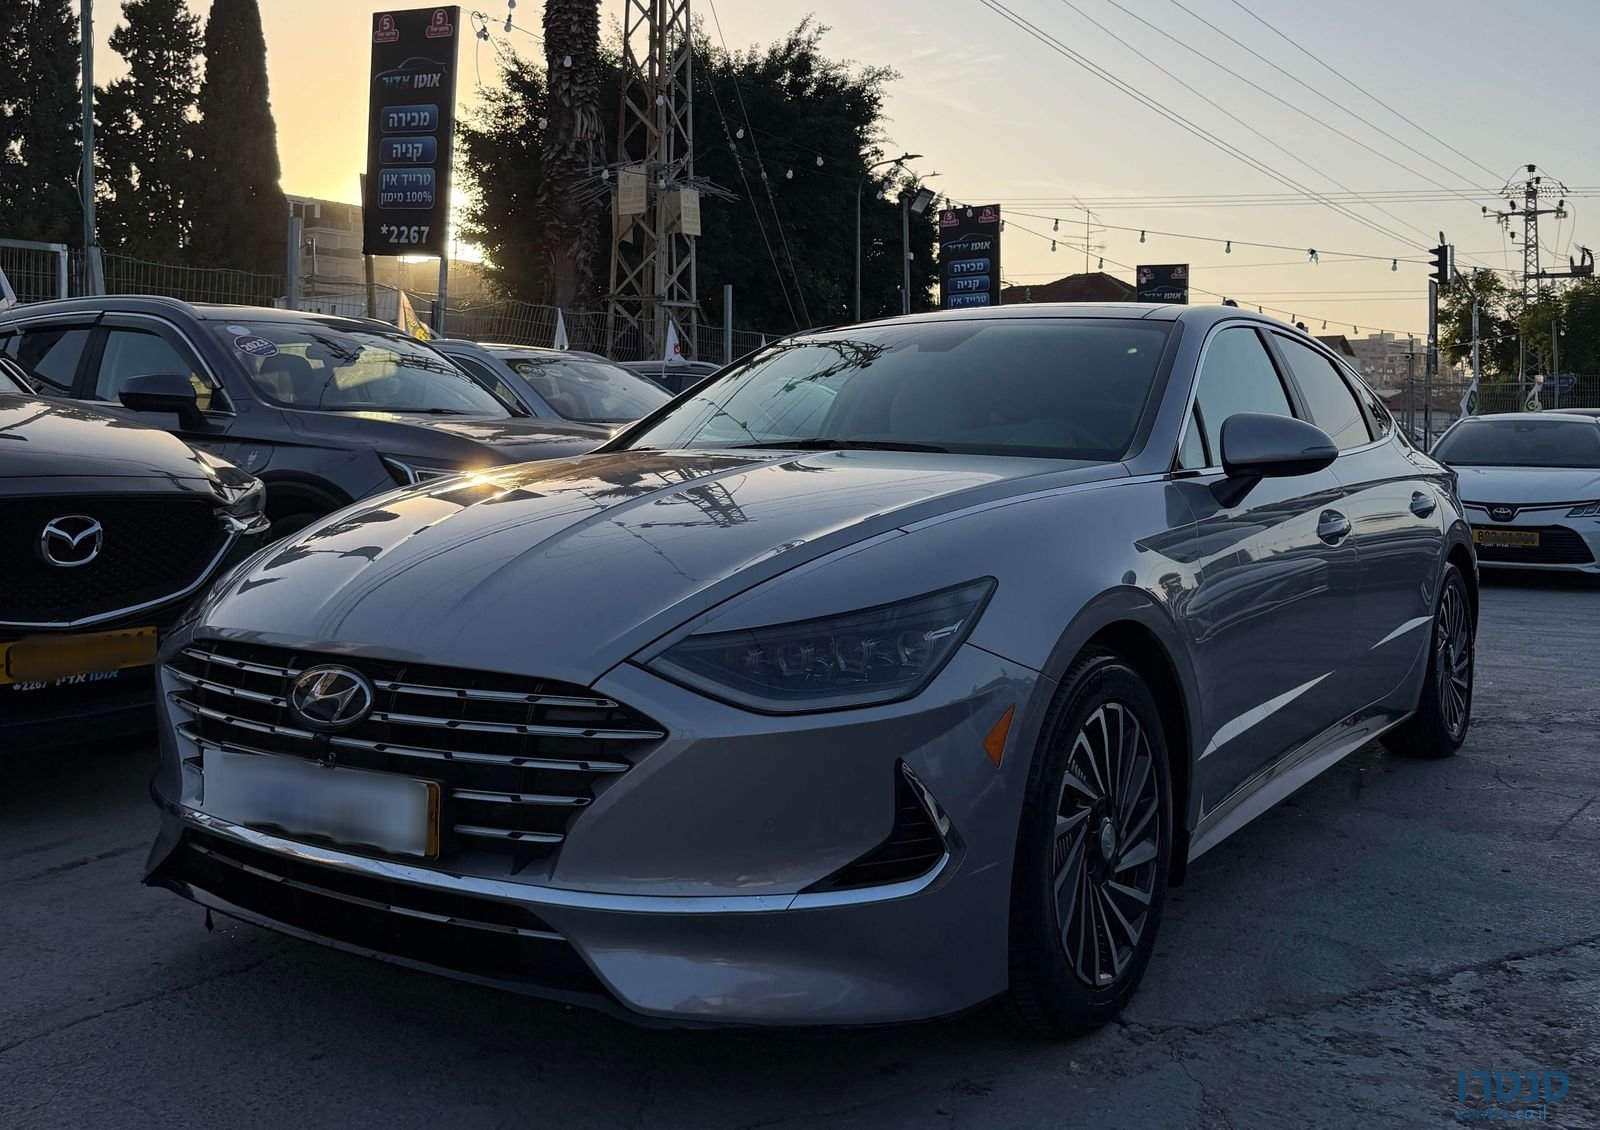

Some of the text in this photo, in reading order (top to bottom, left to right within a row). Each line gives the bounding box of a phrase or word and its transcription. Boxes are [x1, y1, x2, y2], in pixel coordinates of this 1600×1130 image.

[383, 17, 391, 30] 5
[436, 11, 444, 25] 5
[382, 72, 441, 89] אוטו אדיר
[389, 110, 430, 128] מכירה
[392, 142, 424, 162] קניה
[382, 172, 431, 189] טרייד אין
[380, 190, 433, 204] 100% מימון
[971, 240, 991, 251] אוטו
[953, 262, 984, 273] מכירה
[957, 279, 980, 290] קניה
[240, 338, 269, 351] 2023
